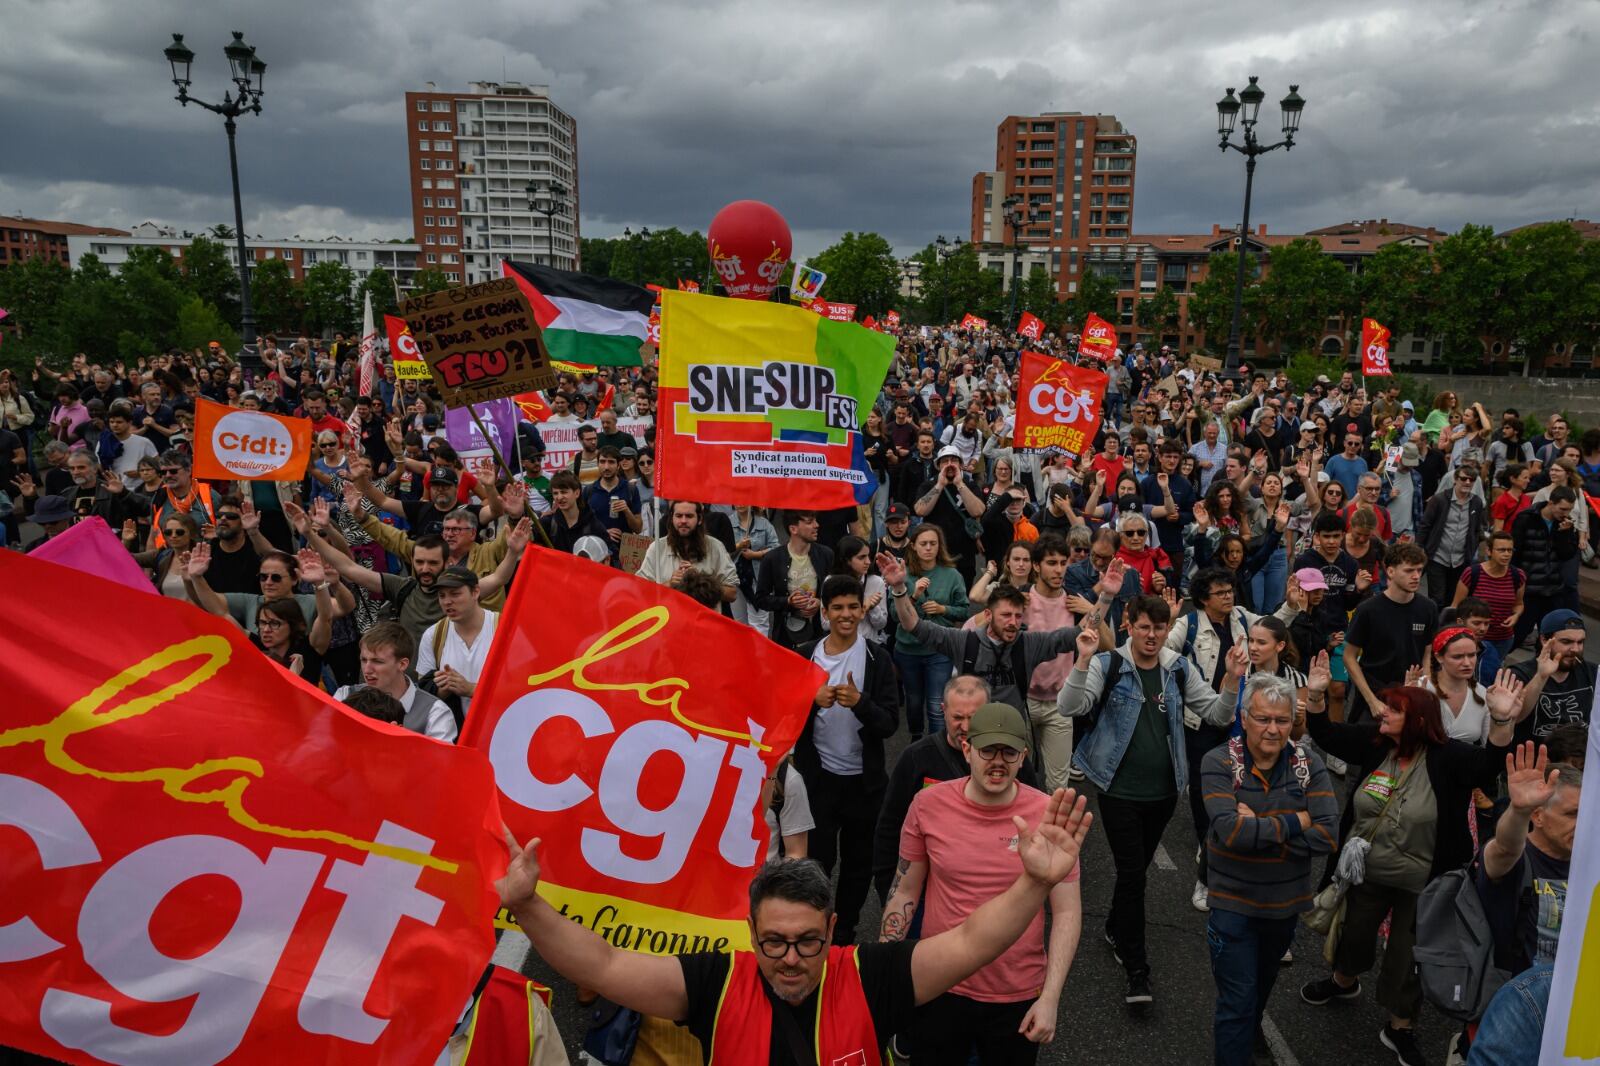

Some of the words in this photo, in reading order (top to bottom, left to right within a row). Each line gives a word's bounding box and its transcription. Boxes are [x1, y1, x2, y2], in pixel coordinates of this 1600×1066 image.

[1088, 327, 1107, 338] cgt
[690, 362, 835, 413] SNESUP
[1028, 383, 1095, 423] cgt
[1024, 424, 1086, 443] COMMERCE
[1024, 436, 1032, 447] &
[1036, 433, 1083, 454] SERVICES
[733, 451, 781, 463] Syndicat
[784, 454, 826, 465] national
[734, 464, 748, 474] de
[528, 606, 772, 752] la
[0, 635, 459, 874] la
[489, 688, 767, 884] cgt
[1533, 879, 1557, 897] LA
[592, 905, 729, 955] Garonne
